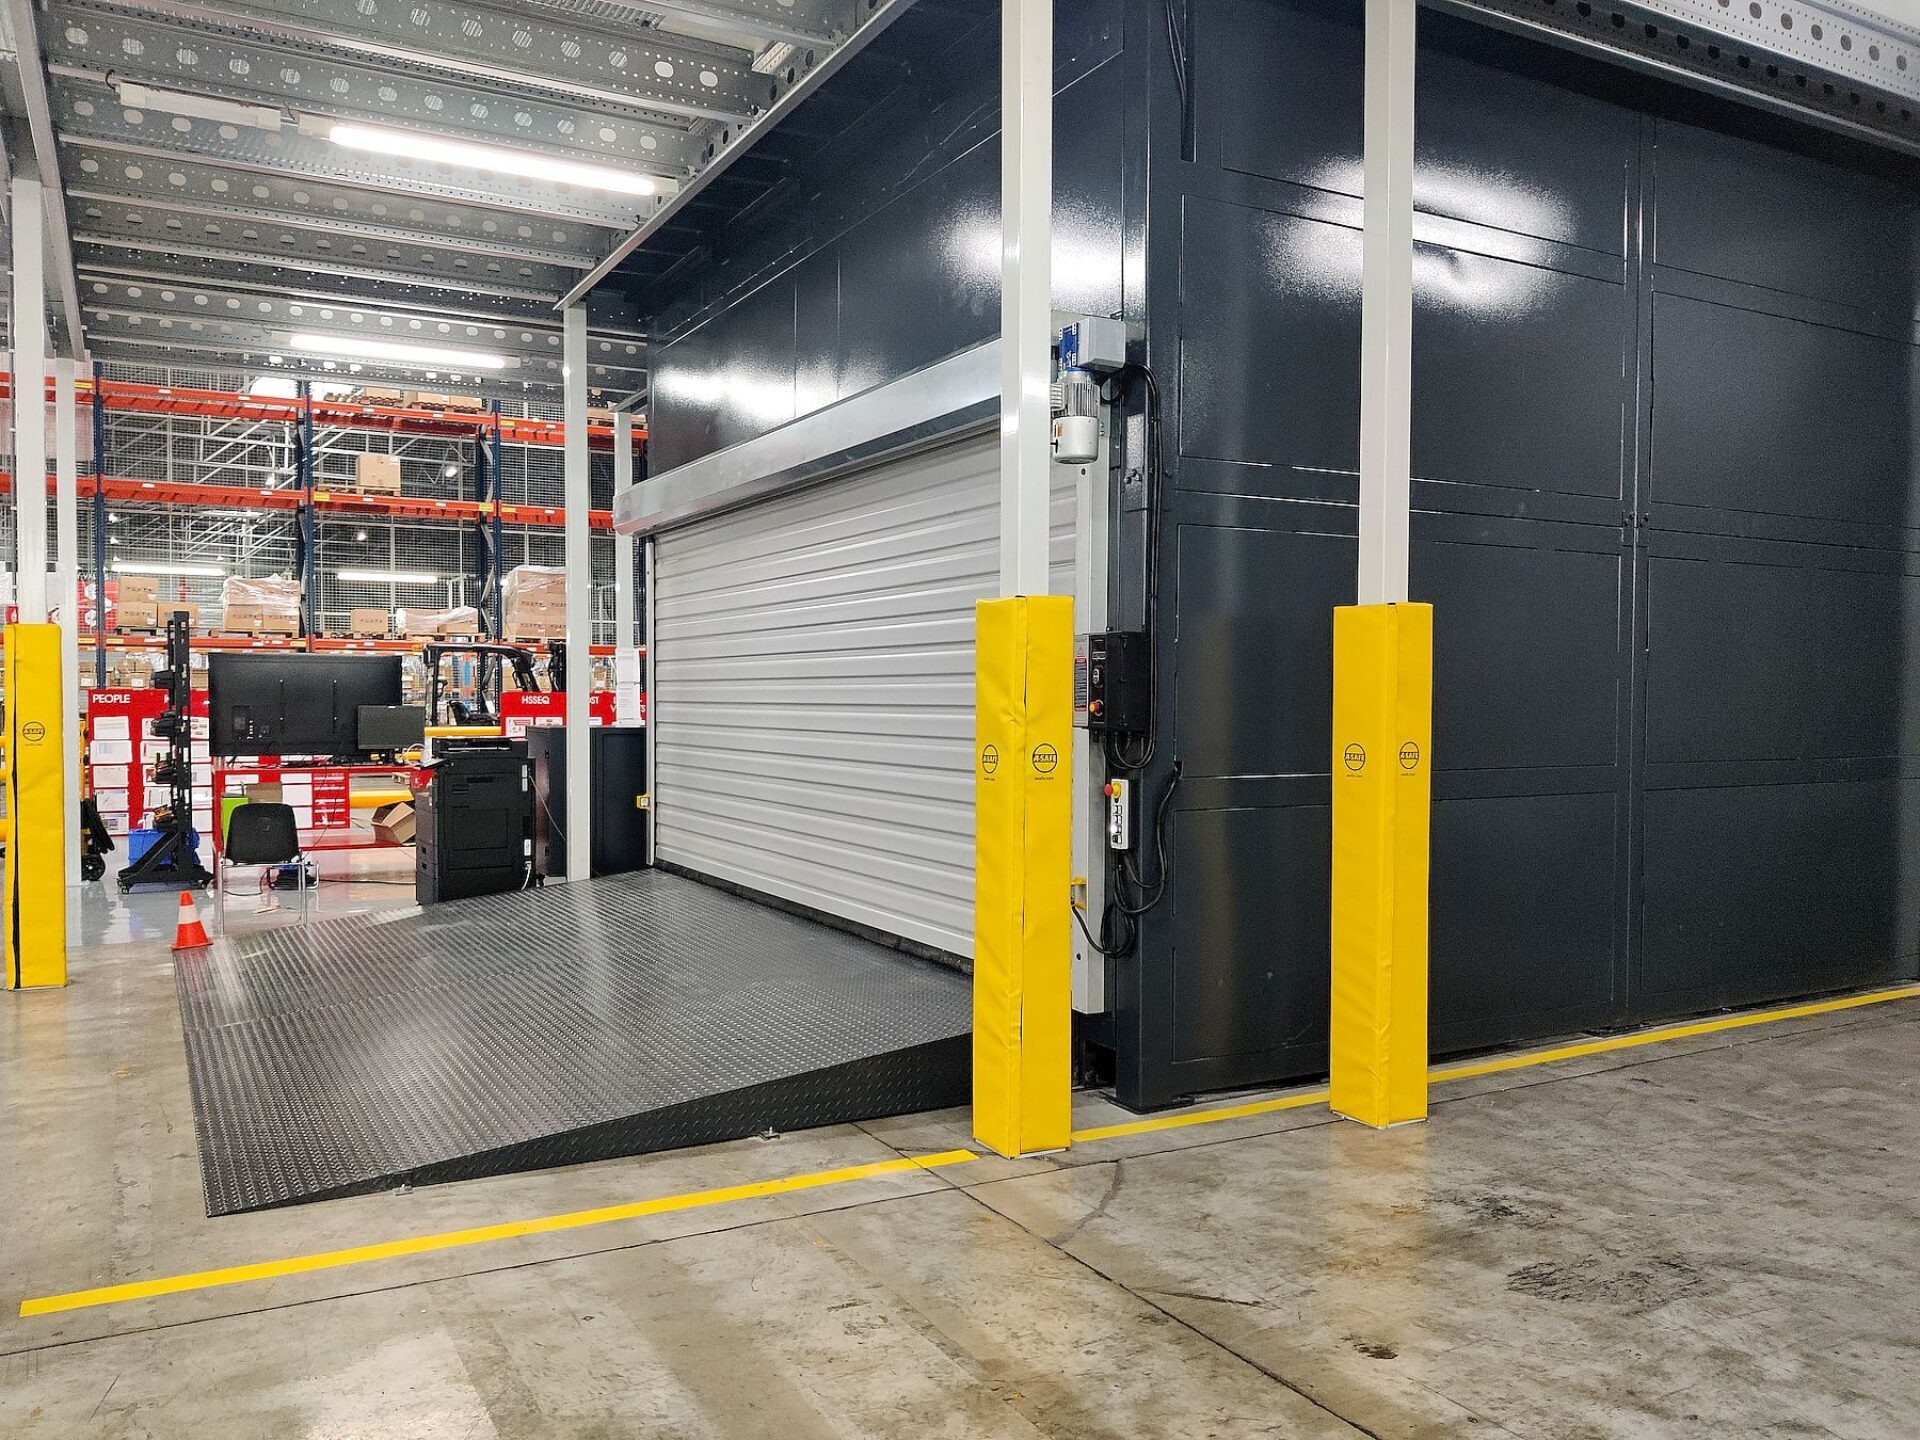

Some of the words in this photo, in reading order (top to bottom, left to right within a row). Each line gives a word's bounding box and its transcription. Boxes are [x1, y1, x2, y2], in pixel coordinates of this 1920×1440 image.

[92, 694, 131, 704] PEOPLE
[521, 695, 550, 705] HSSEQ
[1033, 754, 1057, 763] A-SAFE
